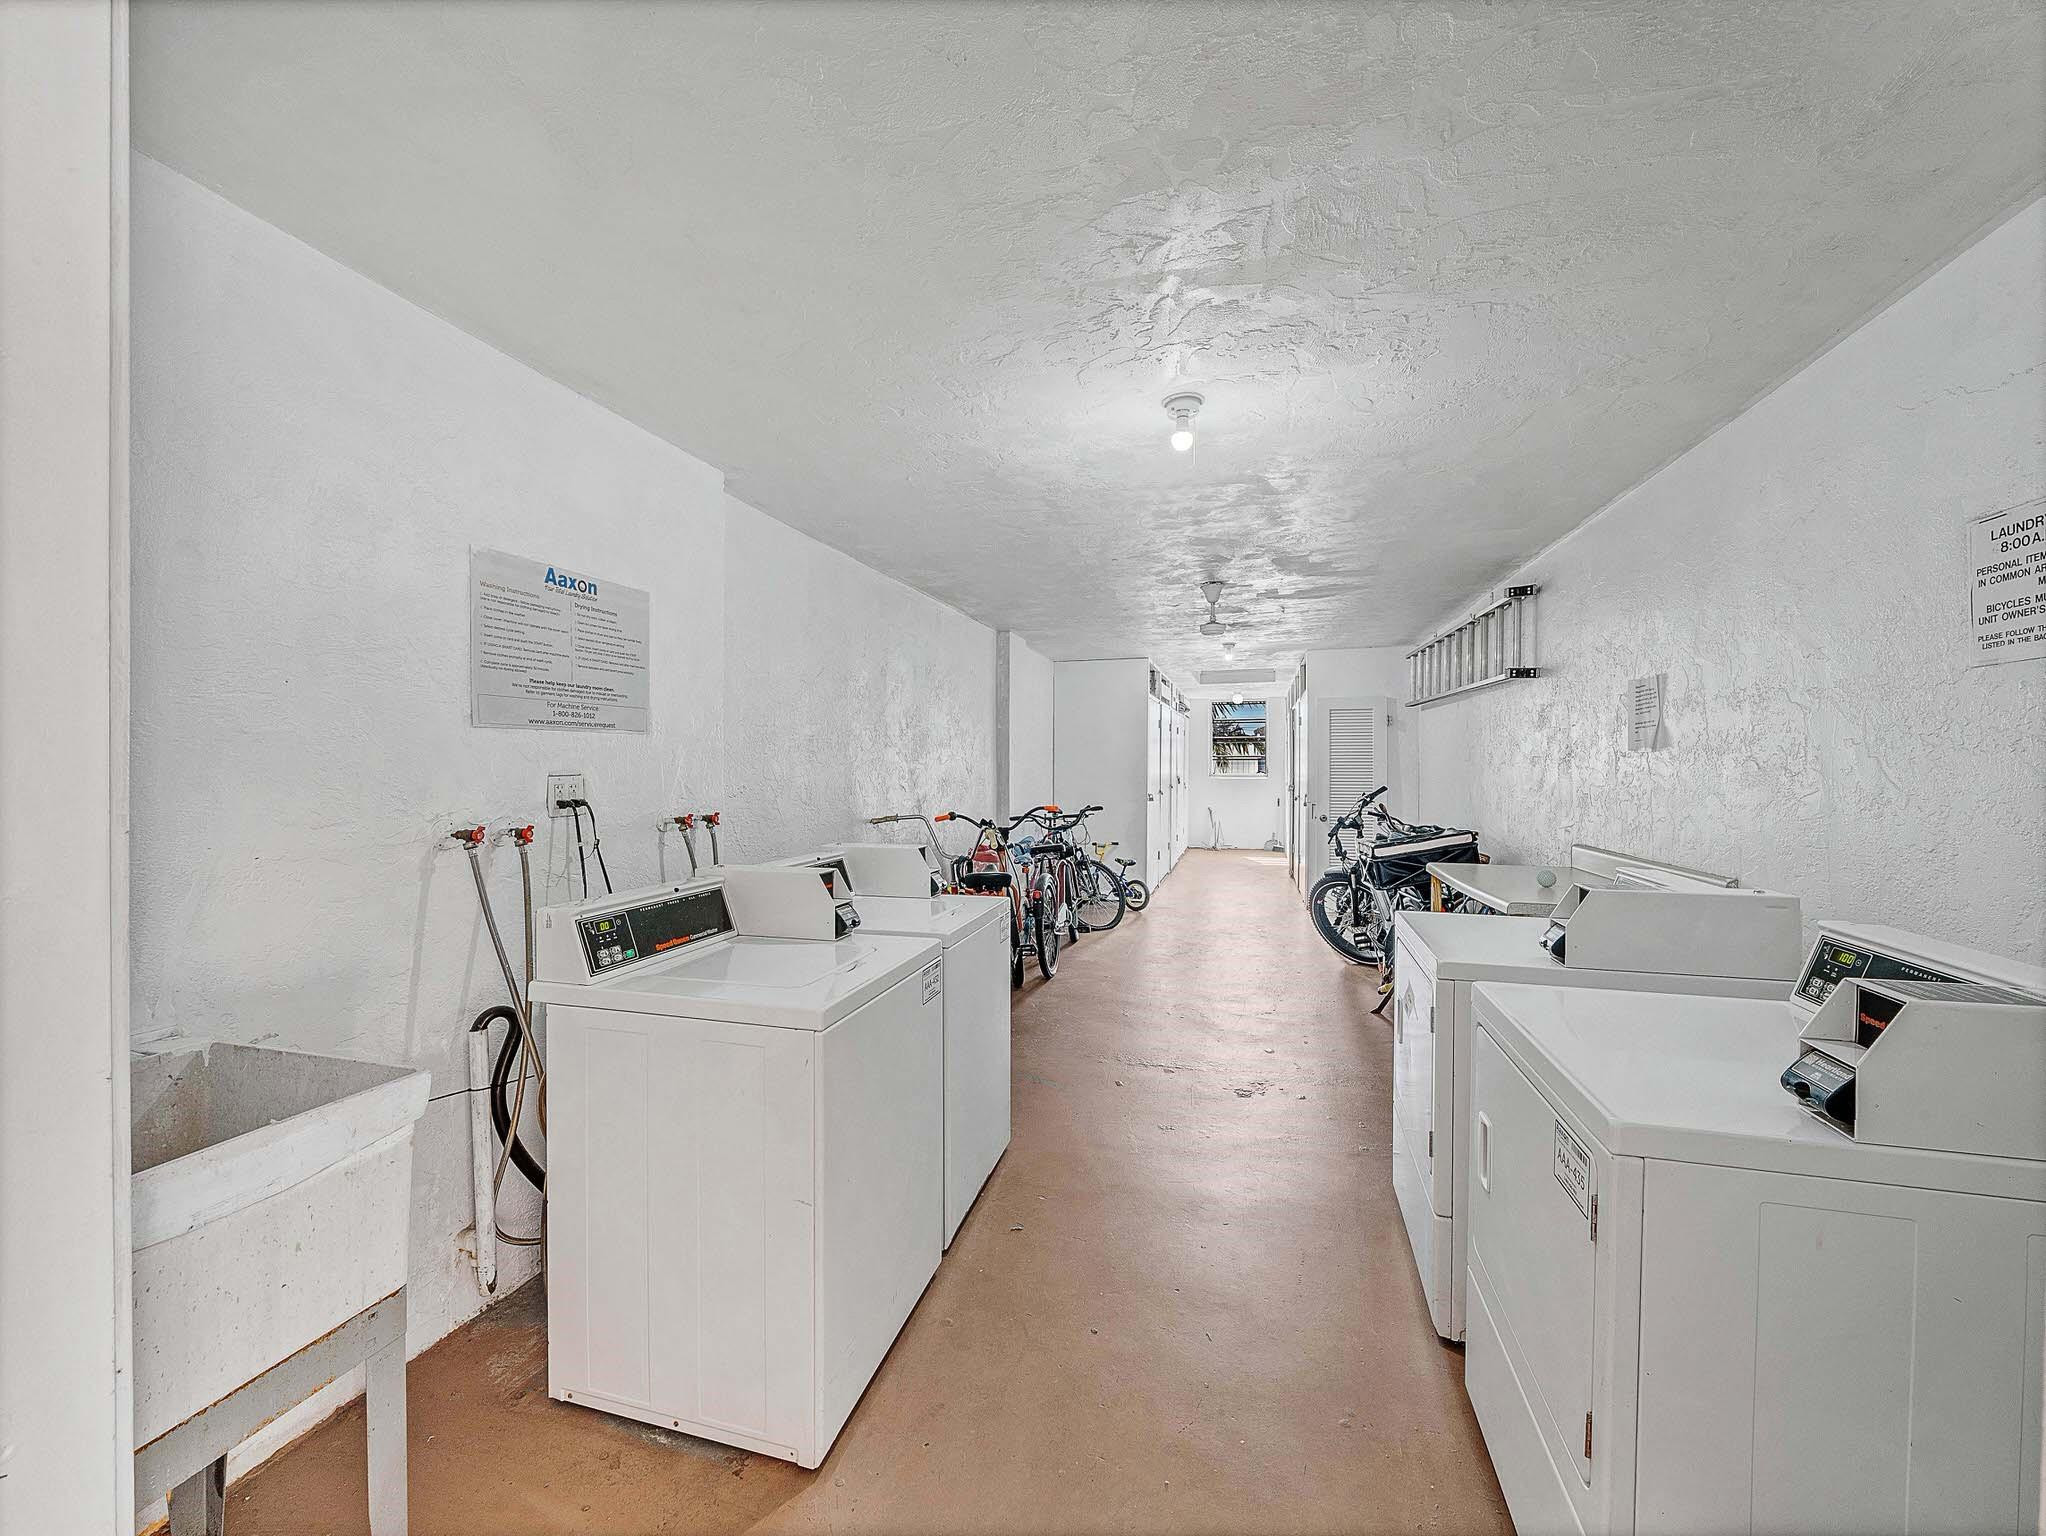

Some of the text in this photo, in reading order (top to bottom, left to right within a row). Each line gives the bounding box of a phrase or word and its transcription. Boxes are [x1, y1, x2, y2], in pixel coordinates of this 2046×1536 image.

[1991, 514, 2046, 541] LAUNDR
[2001, 535, 2030, 552] 8:00
[1977, 558, 2022, 577] PERSONAL
[544, 567, 597, 595] Aaxon
[1978, 579, 1986, 588] IN
[1990, 567, 2030, 585] COMMON
[480, 580, 540, 599] Washing Instructions
[575, 602, 618, 617] Drying Instructions
[1987, 597, 2031, 613] BICYCLES
[1979, 604, 2046, 625] UNIT OWNER'S
[1978, 632, 2003, 642] PLEASE
[2006, 626, 2035, 638] FOLLOW
[1982, 641, 2005, 650] LISTED
[552, 710, 596, 719] 1-800-826-1012
[557, 702, 580, 710] Machine
[581, 704, 599, 712] Service
[1839, 952, 1856, 965] 100
[1901, 966, 1941, 982] PERMANENT
[1860, 1012, 1887, 1030] Speed
[1815, 1058, 1854, 1080] Heartland
[1557, 1147, 1585, 1191] AAA-435
